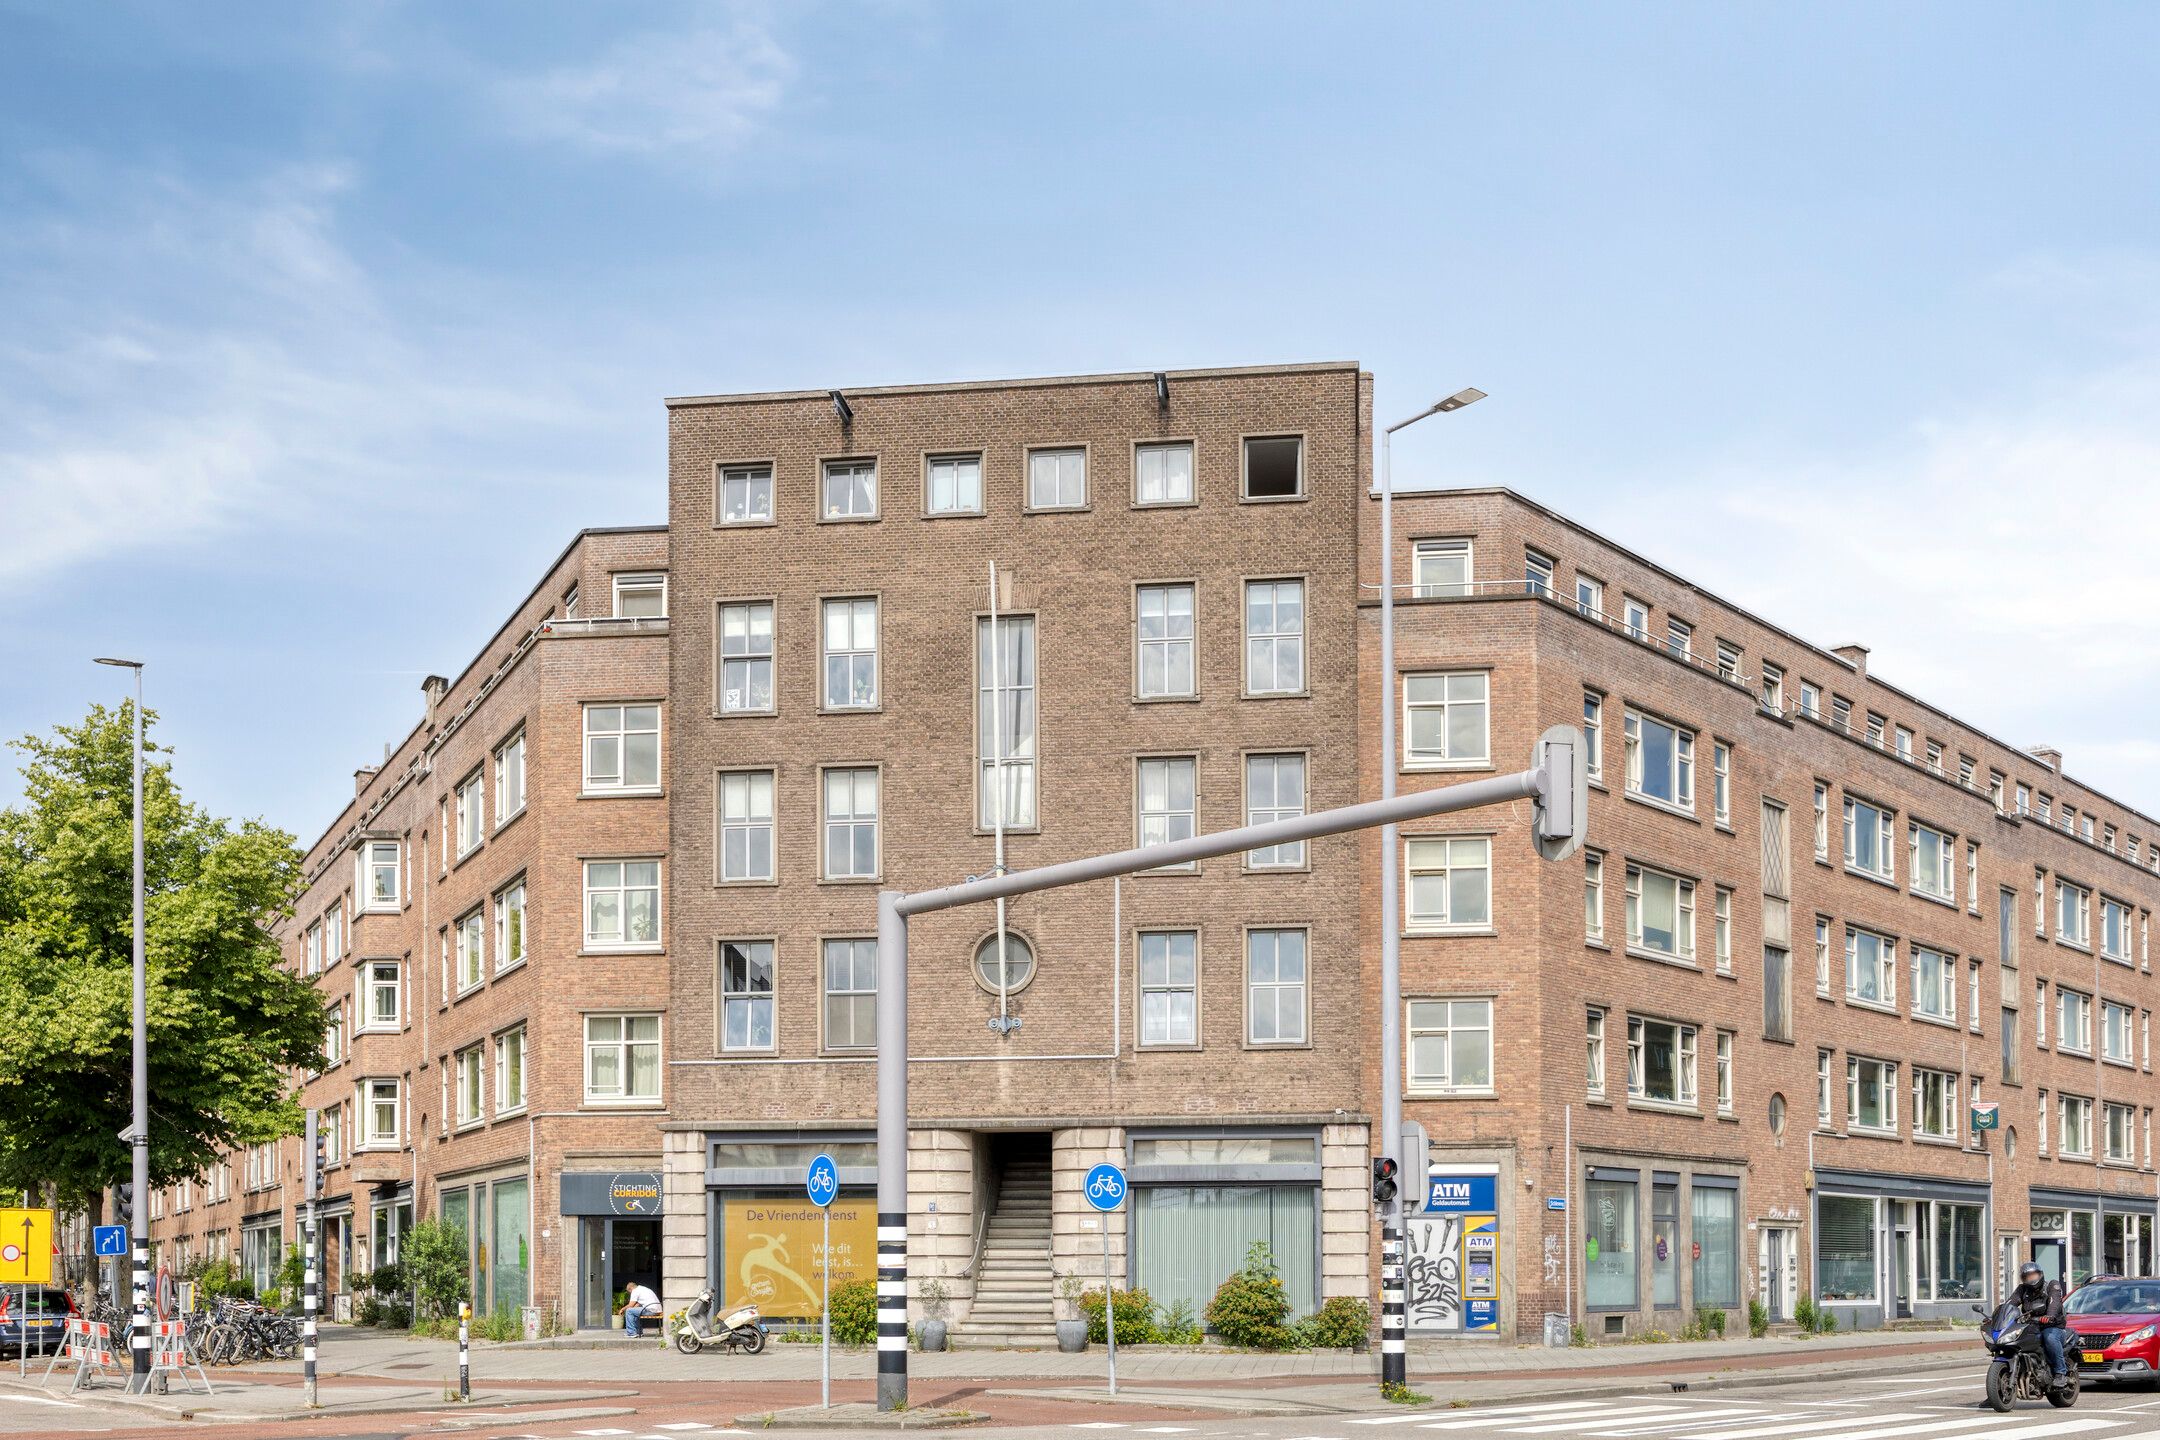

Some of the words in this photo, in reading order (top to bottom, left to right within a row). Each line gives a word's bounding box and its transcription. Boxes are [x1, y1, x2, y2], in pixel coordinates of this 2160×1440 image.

[613, 1189, 657, 1198] CORRIDOR
[1432, 1183, 1470, 1197] ATM
[747, 1210, 764, 1221] De
[1469, 1238, 1493, 1247] ATM
[812, 1243, 835, 1254] We
[837, 1243, 852, 1254] dit
[1471, 1301, 1490, 1309] ATM
